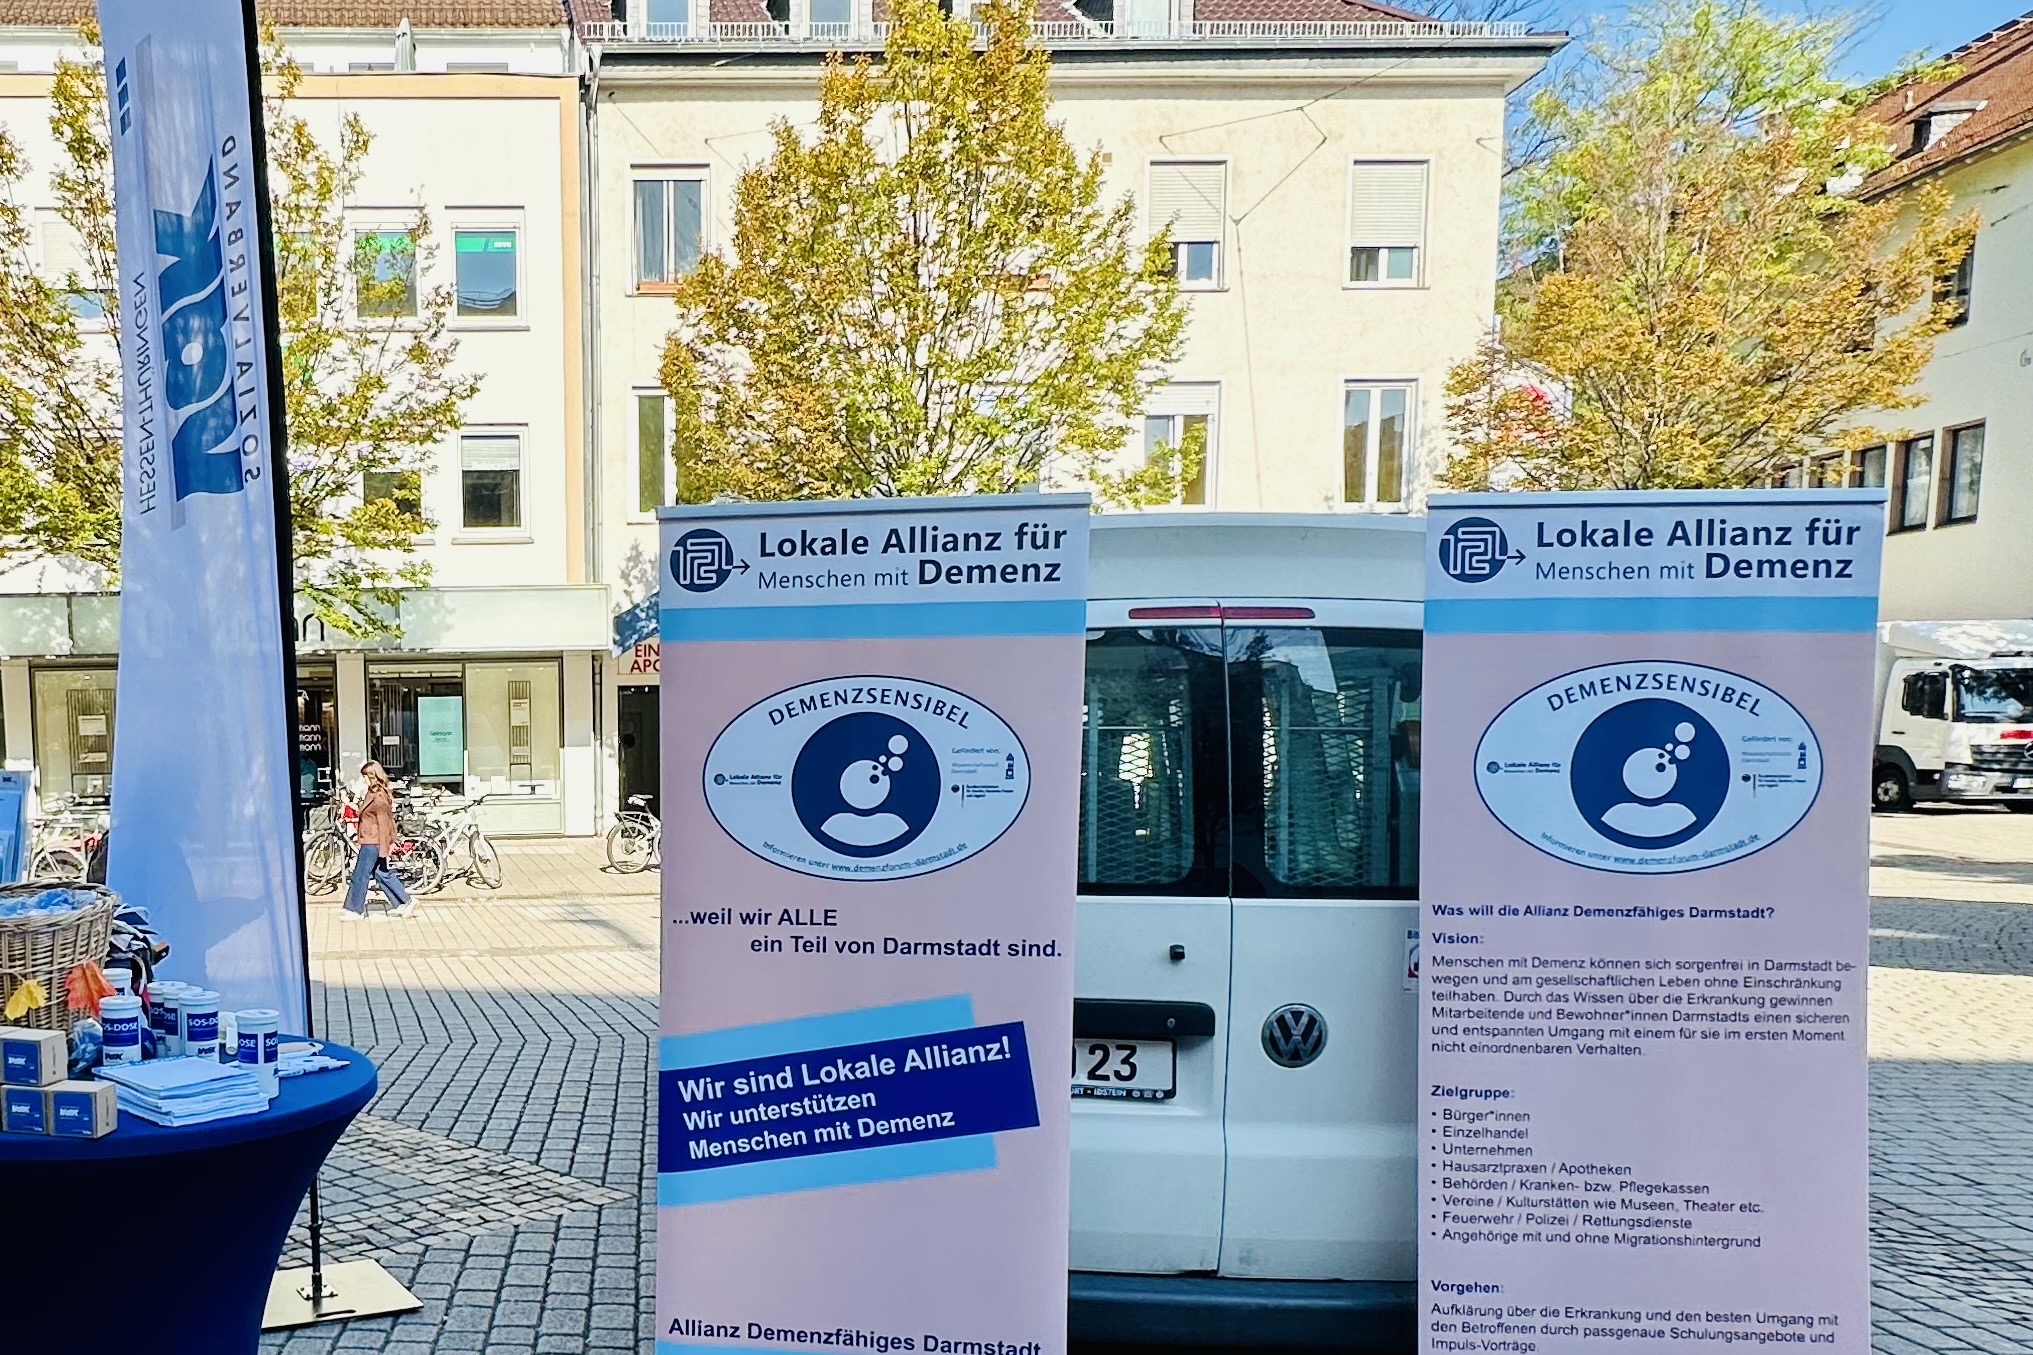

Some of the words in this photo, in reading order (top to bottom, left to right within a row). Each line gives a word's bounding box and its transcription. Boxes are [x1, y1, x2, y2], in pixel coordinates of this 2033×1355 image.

[759, 527, 868, 557] Lokale
[880, 525, 1002, 554] Allianz
[1014, 521, 1067, 550] für
[1536, 519, 1653, 548] Lokale
[1666, 518, 1792, 546] Allianz
[1804, 517, 1861, 546] für
[758, 568, 865, 589] Menschen
[874, 567, 908, 586] mit
[918, 559, 1061, 584] Demenz
[1536, 560, 1649, 580] Menschen
[1660, 560, 1694, 579] mit
[1705, 552, 1853, 578] Demenz
[1546, 672, 1762, 717] DEMENZSENSIBEL
[768, 687, 970, 730] DEMENZSENSIBEL
[738, 908, 772, 925] wir
[777, 908, 837, 926] ALLE
[1431, 904, 1464, 916] Was
[1468, 904, 1493, 916] will
[1497, 904, 1519, 916] die
[1523, 904, 1569, 916] Allianz
[1573, 905, 1685, 920] Demenzfähiges
[1689, 906, 1774, 918] Darmstadt?
[750, 934, 782, 952] ein
[789, 935, 826, 953] Teil
[834, 940, 874, 954] von
[883, 936, 1000, 956] Darmstadt
[1007, 938, 1061, 957] sind.
[1431, 932, 1485, 944] Vision:
[1432, 955, 1504, 968] Menschen
[1508, 956, 1527, 967] mit
[1531, 956, 1586, 969] Demenz
[1589, 956, 1640, 969] können
[1644, 958, 1671, 970] sich
[1675, 958, 1743, 973] sorgenfrei
[1747, 961, 1759, 970] in
[1764, 958, 1832, 972] Darmstadt
[1431, 975, 1478, 987] wegen
[1482, 973, 1508, 985] und
[1511, 976, 1532, 985] am
[1535, 974, 1654, 988] gesellschaftlichen
[1659, 975, 1700, 987] Leben
[1704, 976, 1738, 988] ohne
[1743, 975, 1841, 992] Einschränkung
[1503, 990, 1542, 1002] Durch
[1545, 991, 1569, 1003] das
[1573, 991, 1624, 1004] Wissen
[1628, 992, 1659, 1004] über
[1662, 992, 1683, 1005] die
[1686, 992, 1765, 1009] Erkrankung
[1769, 994, 1832, 1008] gewinnen
[1432, 1007, 1524, 1019] Mitarbeitende
[1528, 1008, 1552, 1020] und
[1672, 1009, 1749, 1022] Darmstadts
[1753, 1011, 1791, 1023] einen
[1795, 1012, 1849, 1024] sicheren
[1431, 1024, 1458, 1035] und
[1462, 1025, 1544, 1038] entspannten
[1548, 1025, 1604, 1041] Umgang
[1609, 1027, 1630, 1038] mit
[1633, 1026, 1675, 1039] einem
[1678, 1026, 1697, 1039] für
[1700, 1028, 1720, 1039] sie
[1724, 1028, 1740, 1039] im
[1744, 1029, 1788, 1040] ersten
[1792, 1029, 1844, 1041] Moment
[1431, 1041, 1466, 1052] nicht
[677, 1077, 725, 1102] Wir
[733, 1065, 793, 1095] sind
[800, 1053, 895, 1086] Lokale
[903, 1035, 1010, 1072] Allianz!
[1430, 1084, 1516, 1100] Zielgruppe:
[682, 1109, 723, 1130] Wir
[729, 1092, 876, 1124] unterstützen
[688, 1130, 807, 1159] Menschen
[813, 1121, 852, 1143] mit
[857, 1111, 955, 1137] Demenz
[1442, 1126, 1528, 1139] Einzelhandel
[1442, 1143, 1532, 1156] Unternehmen
[1442, 1160, 1547, 1176] Hausarztpraxen
[1558, 1162, 1631, 1176] Apotheken
[1442, 1177, 1507, 1190] Behörden
[1519, 1178, 1579, 1191] Kranken-
[1619, 1180, 1709, 1196] Pflegekassen
[1442, 1194, 1494, 1207] Vereine
[1506, 1195, 1589, 1209] Kulturstätten
[1592, 1198, 1616, 1210] wie
[1683, 1199, 1735, 1212] Theater
[1738, 1201, 1763, 1213] etc.
[1442, 1211, 1514, 1224] Feuerwehr
[1525, 1212, 1569, 1226] Polizei
[1582, 1214, 1692, 1230] Rettungsdienste
[1441, 1228, 1518, 1244] Angehörige
[1522, 1230, 1541, 1242] mit
[1545, 1231, 1571, 1242] und
[1574, 1231, 1609, 1244] ohne
[1614, 1232, 1760, 1249] Migrationshintergrund
[1430, 1302, 1503, 1320] Aufklärung
[1506, 1305, 1537, 1317] über
[1539, 1305, 1560, 1318] die
[1564, 1306, 1641, 1323] Erkrankung
[1645, 1309, 1671, 1321] und
[1675, 1310, 1701, 1322] den
[1705, 1310, 1751, 1323] besten
[1755, 1312, 1814, 1328] Umgang
[1818, 1314, 1838, 1326] mit
[668, 1317, 740, 1338] Allianz
[747, 1322, 915, 1352] Demenzfähiges
[923, 1334, 1041, 1355] Darmstadt
[1430, 1320, 1457, 1334] den
[1461, 1321, 1536, 1334] Betroffenen
[1540, 1323, 1578, 1335] durch
[1583, 1327, 1665, 1340] passgenaue
[1669, 1326, 1805, 1344] Schulungsangebote
[1809, 1331, 1834, 1343] und
